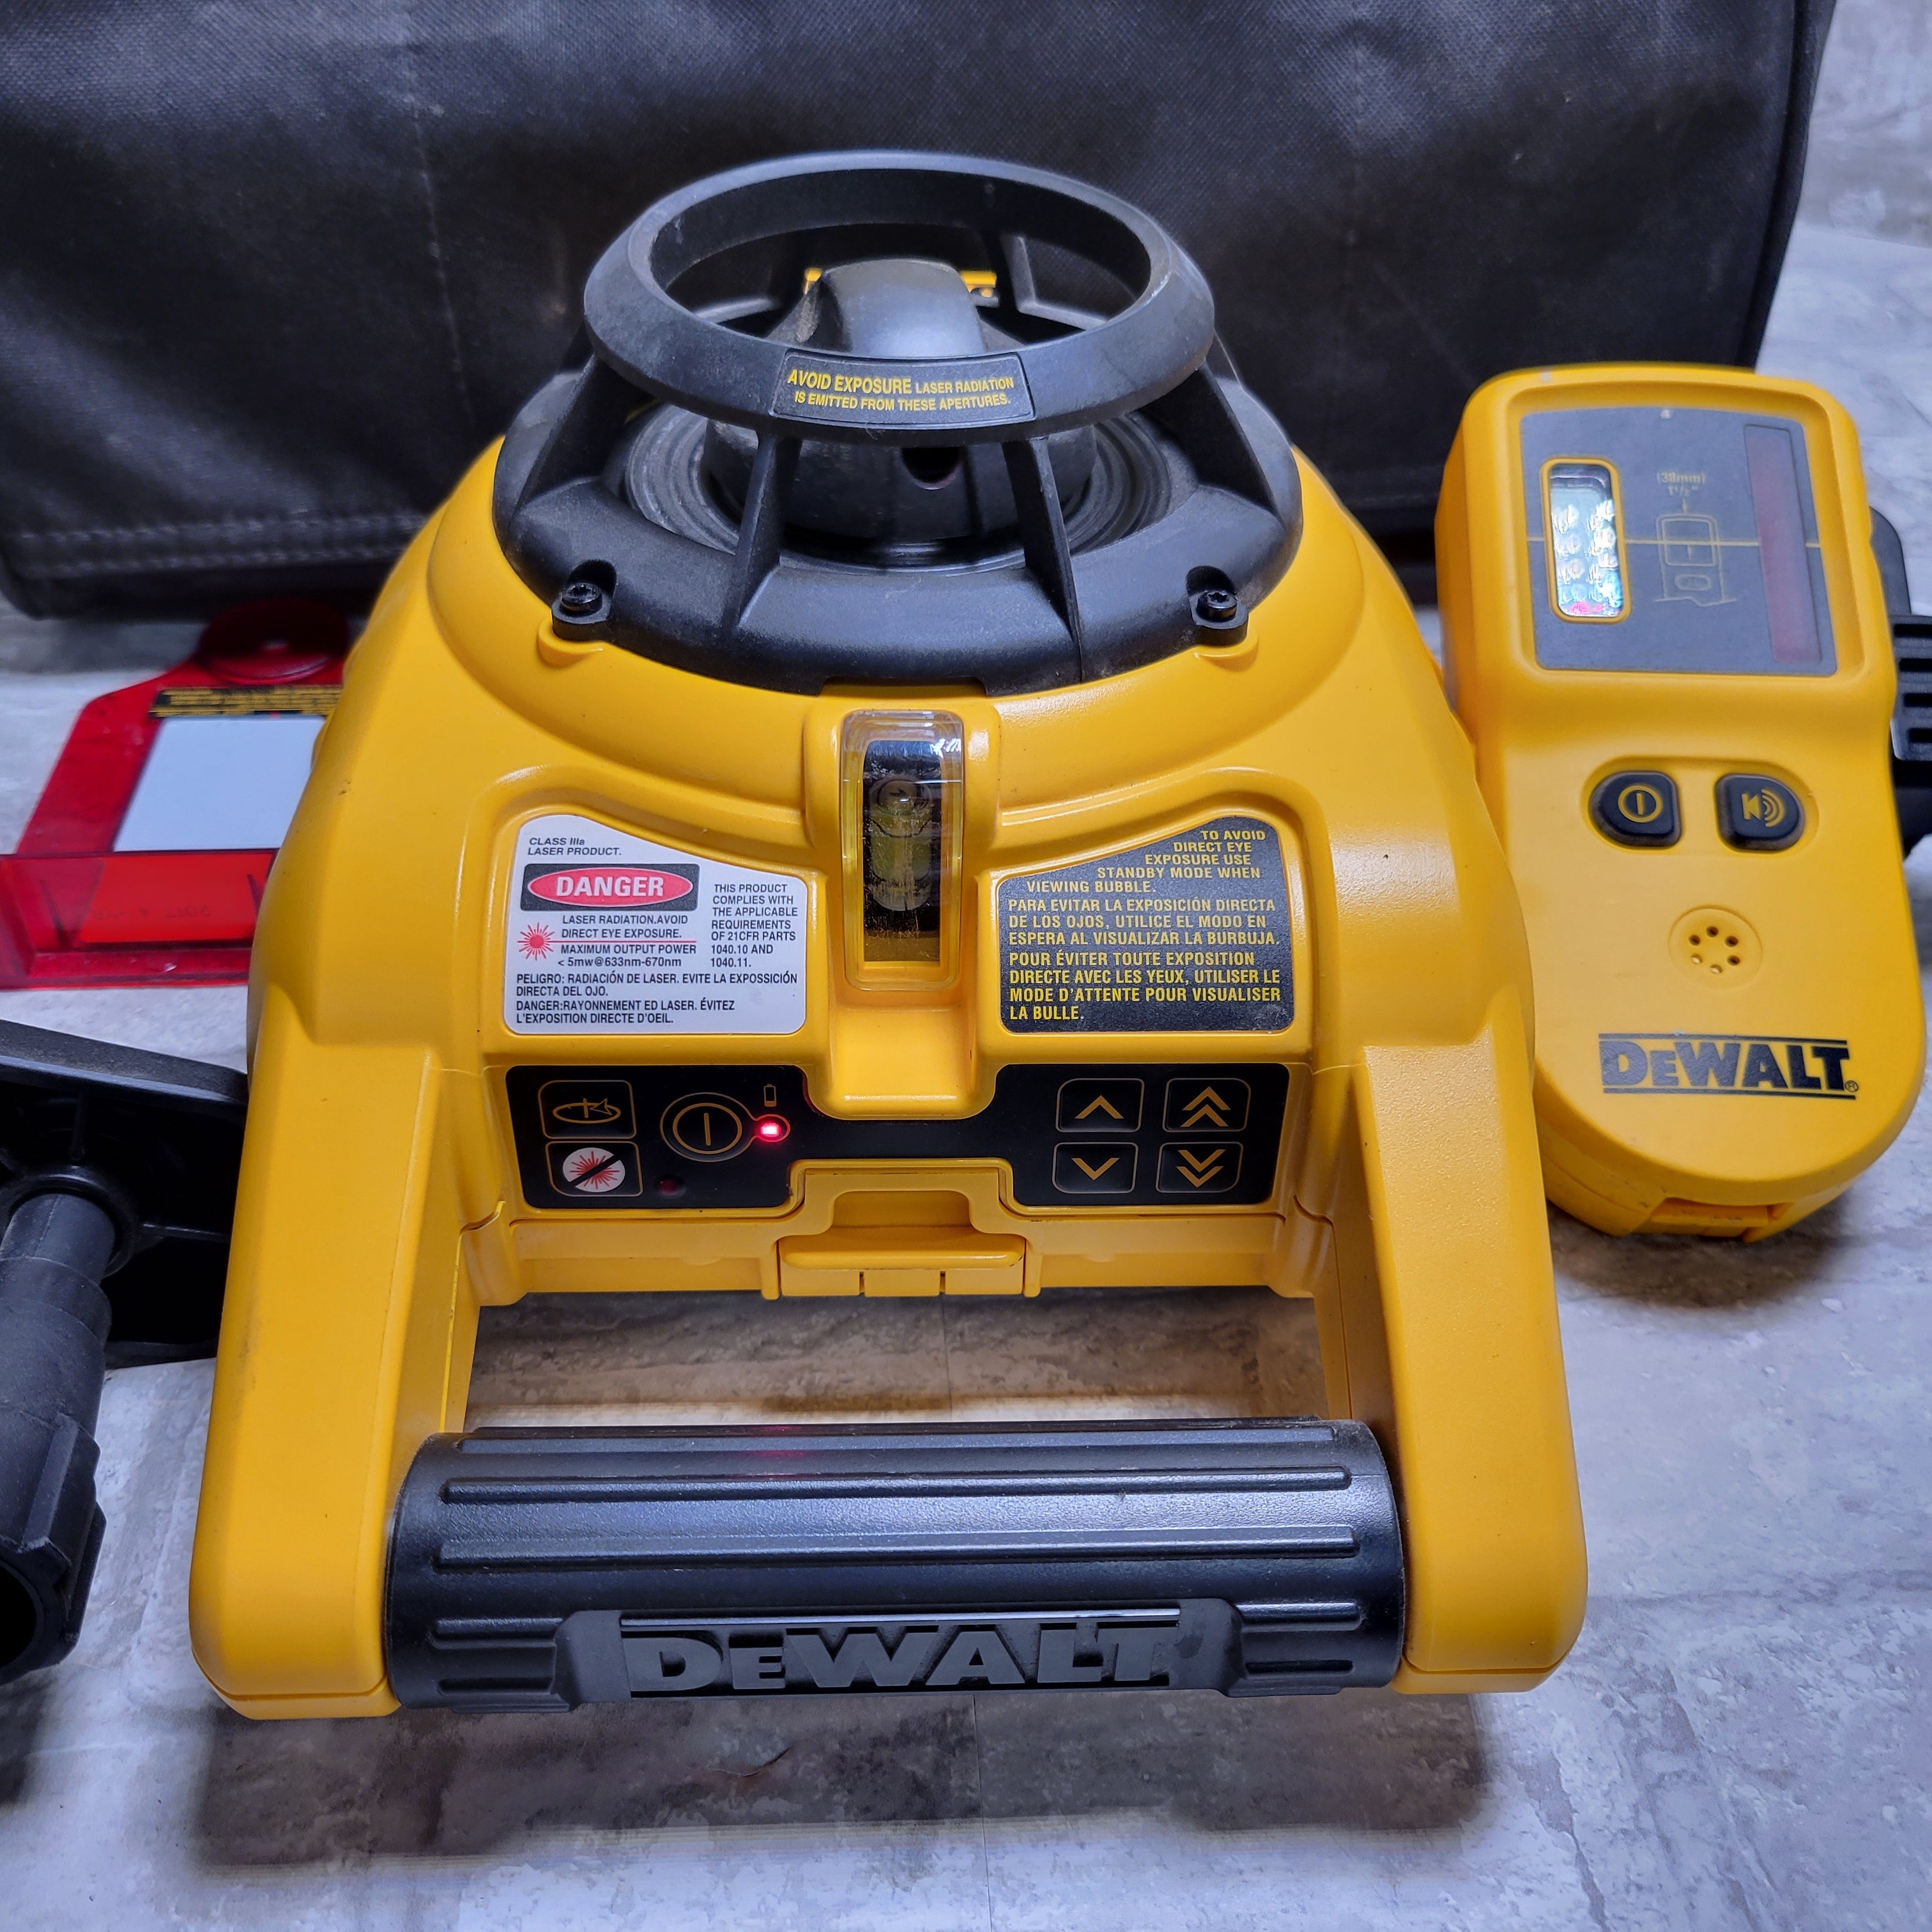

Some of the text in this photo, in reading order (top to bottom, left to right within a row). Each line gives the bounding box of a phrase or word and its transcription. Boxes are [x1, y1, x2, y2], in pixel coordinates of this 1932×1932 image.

[788, 369, 1015, 394] AVOID EXPOSURE LASER RADIATION
[795, 390, 1011, 411] IS EMITTED FROM THESE APERTURES.
[1200, 831, 1266, 840] TO AVOID
[529, 838, 567, 846] CLASS
[1174, 842, 1252, 852] DIRECT EYE
[528, 847, 622, 856] LASER PRODUCT.
[1145, 855, 1251, 864] EXPOSURE USE
[1097, 868, 1261, 878] STANDBY MODE WHEN
[556, 877, 664, 897] DANGER
[714, 884, 787, 893] THIS PRODUCT
[1027, 881, 1156, 893] VIEWING BUBBLE.
[712, 896, 793, 905] COMPLIES WITH
[1009, 897, 1275, 911] PARA EVITAR LA EXPOSICIÓN DIRECTA
[713, 907, 798, 916] THE APPLICABLE
[563, 915, 689, 924] LASER RADIATION.AVOID
[1009, 915, 1266, 930] DE LOS OJOS, UTILICE EL MODO EN
[711, 920, 792, 930] REQUIREMENTS
[562, 928, 682, 938] DIRECT EYE EXPOSURE.
[710, 931, 796, 941] OF 21CFR PARTS
[1009, 932, 1279, 945] ESPERA AL VISUALIZAR LA BURBUJA.
[561, 944, 697, 954] MAXIMUM OUTPUT POWER
[711, 945, 773, 954] 1040.10 AND
[1009, 949, 1254, 965] POUR ÉVITER TOUTE EXPOSITION
[710, 958, 751, 967] 1040.11.
[517, 971, 797, 984] PELIGRO: RADIACIÓN DE LASER. EVITE LA EXPOSSICIÓN
[1009, 970, 1280, 985] DIRECTE AVEC LES YEUX, UTILISER LE
[516, 986, 608, 996] DIRECTA DEL OJO.
[1009, 988, 1281, 1002] MODE D'ATTENTE POUR VISUALISER
[516, 997, 735, 1011] DANGER:RAYONNEMENT ED LASER. ÉVITEZ
[517, 1013, 673, 1023] L'EXPOSITION DIRECTE D'OEIL.
[1009, 1006, 1084, 1020] LA BULLE.
